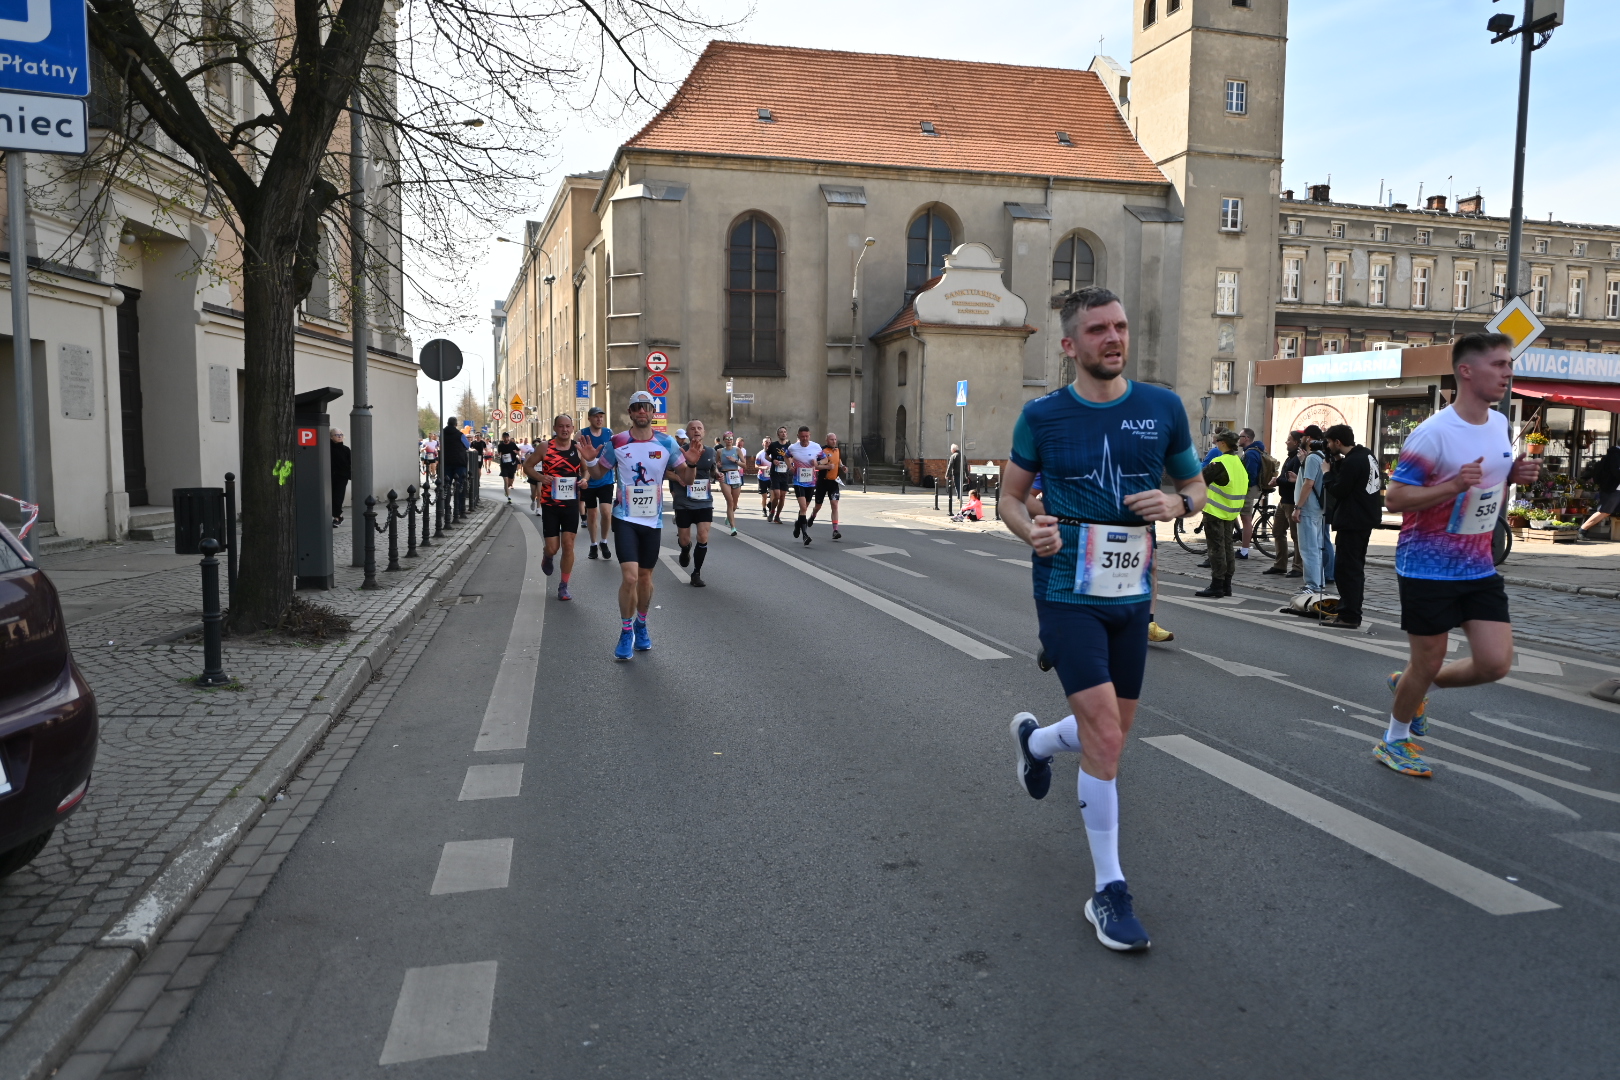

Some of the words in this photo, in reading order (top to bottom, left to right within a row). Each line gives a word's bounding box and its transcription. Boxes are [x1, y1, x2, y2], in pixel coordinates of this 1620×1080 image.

[0, 53, 78, 84] Płatny
[1306, 357, 1398, 375] KWIACIARNIA
[512, 412, 522, 420] 30
[301, 430, 313, 444] P
[632, 496, 654, 505] 9277
[1475, 501, 1497, 517] 538
[1101, 551, 1140, 569] 3186
